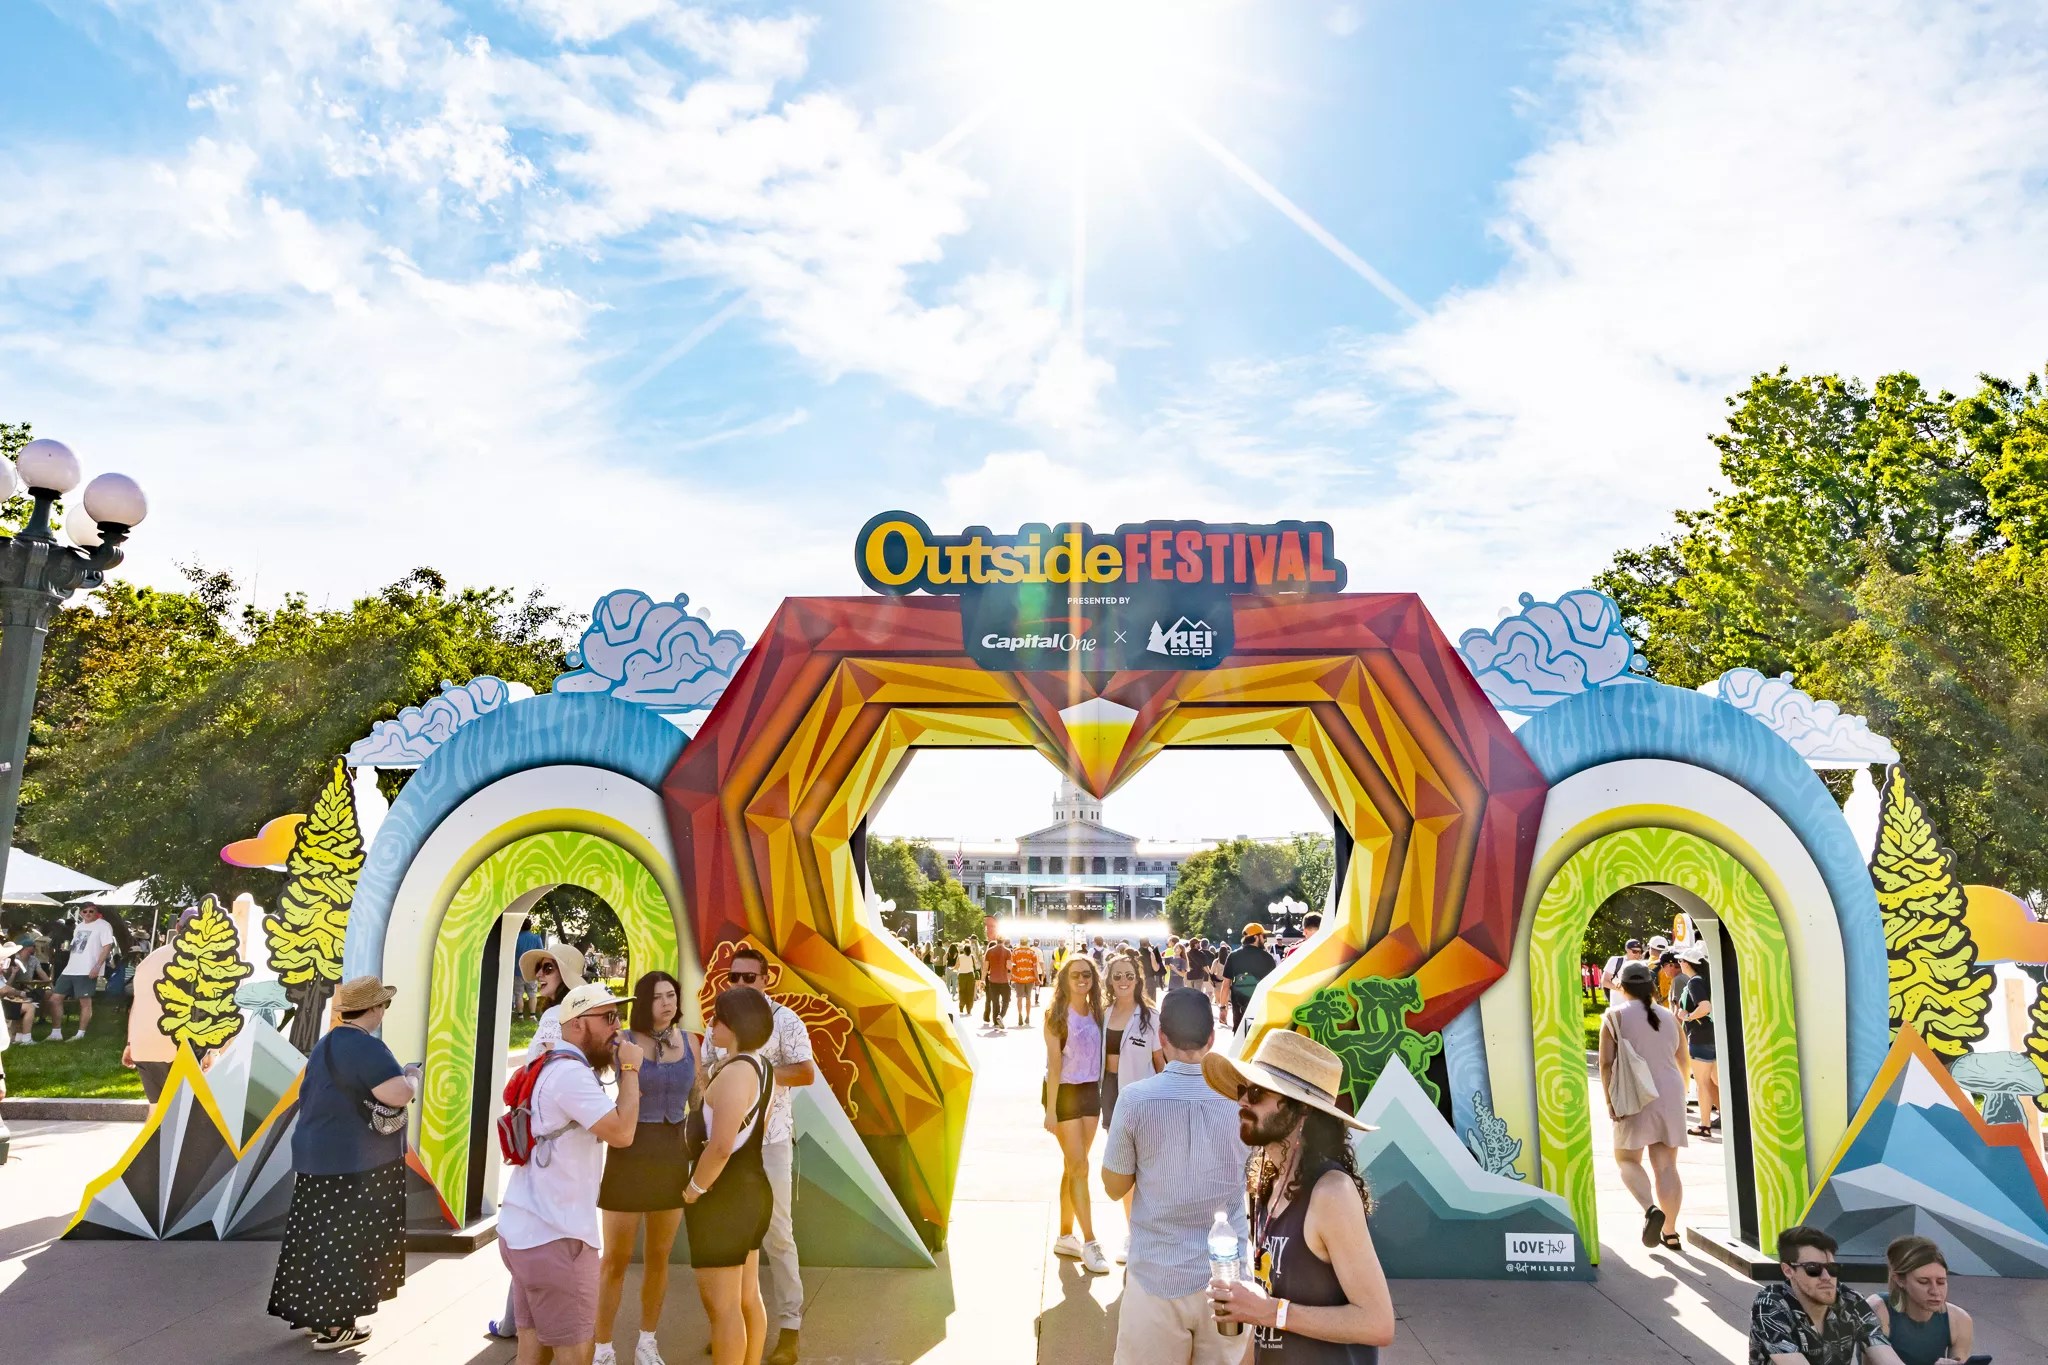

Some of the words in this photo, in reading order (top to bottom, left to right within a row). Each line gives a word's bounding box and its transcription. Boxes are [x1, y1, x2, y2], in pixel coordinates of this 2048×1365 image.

[865, 520, 1123, 585] Outside
[1125, 530, 1337, 585] FESTIVAL
[1067, 597, 1118, 605] PRESENTED
[1119, 596, 1131, 605] BY
